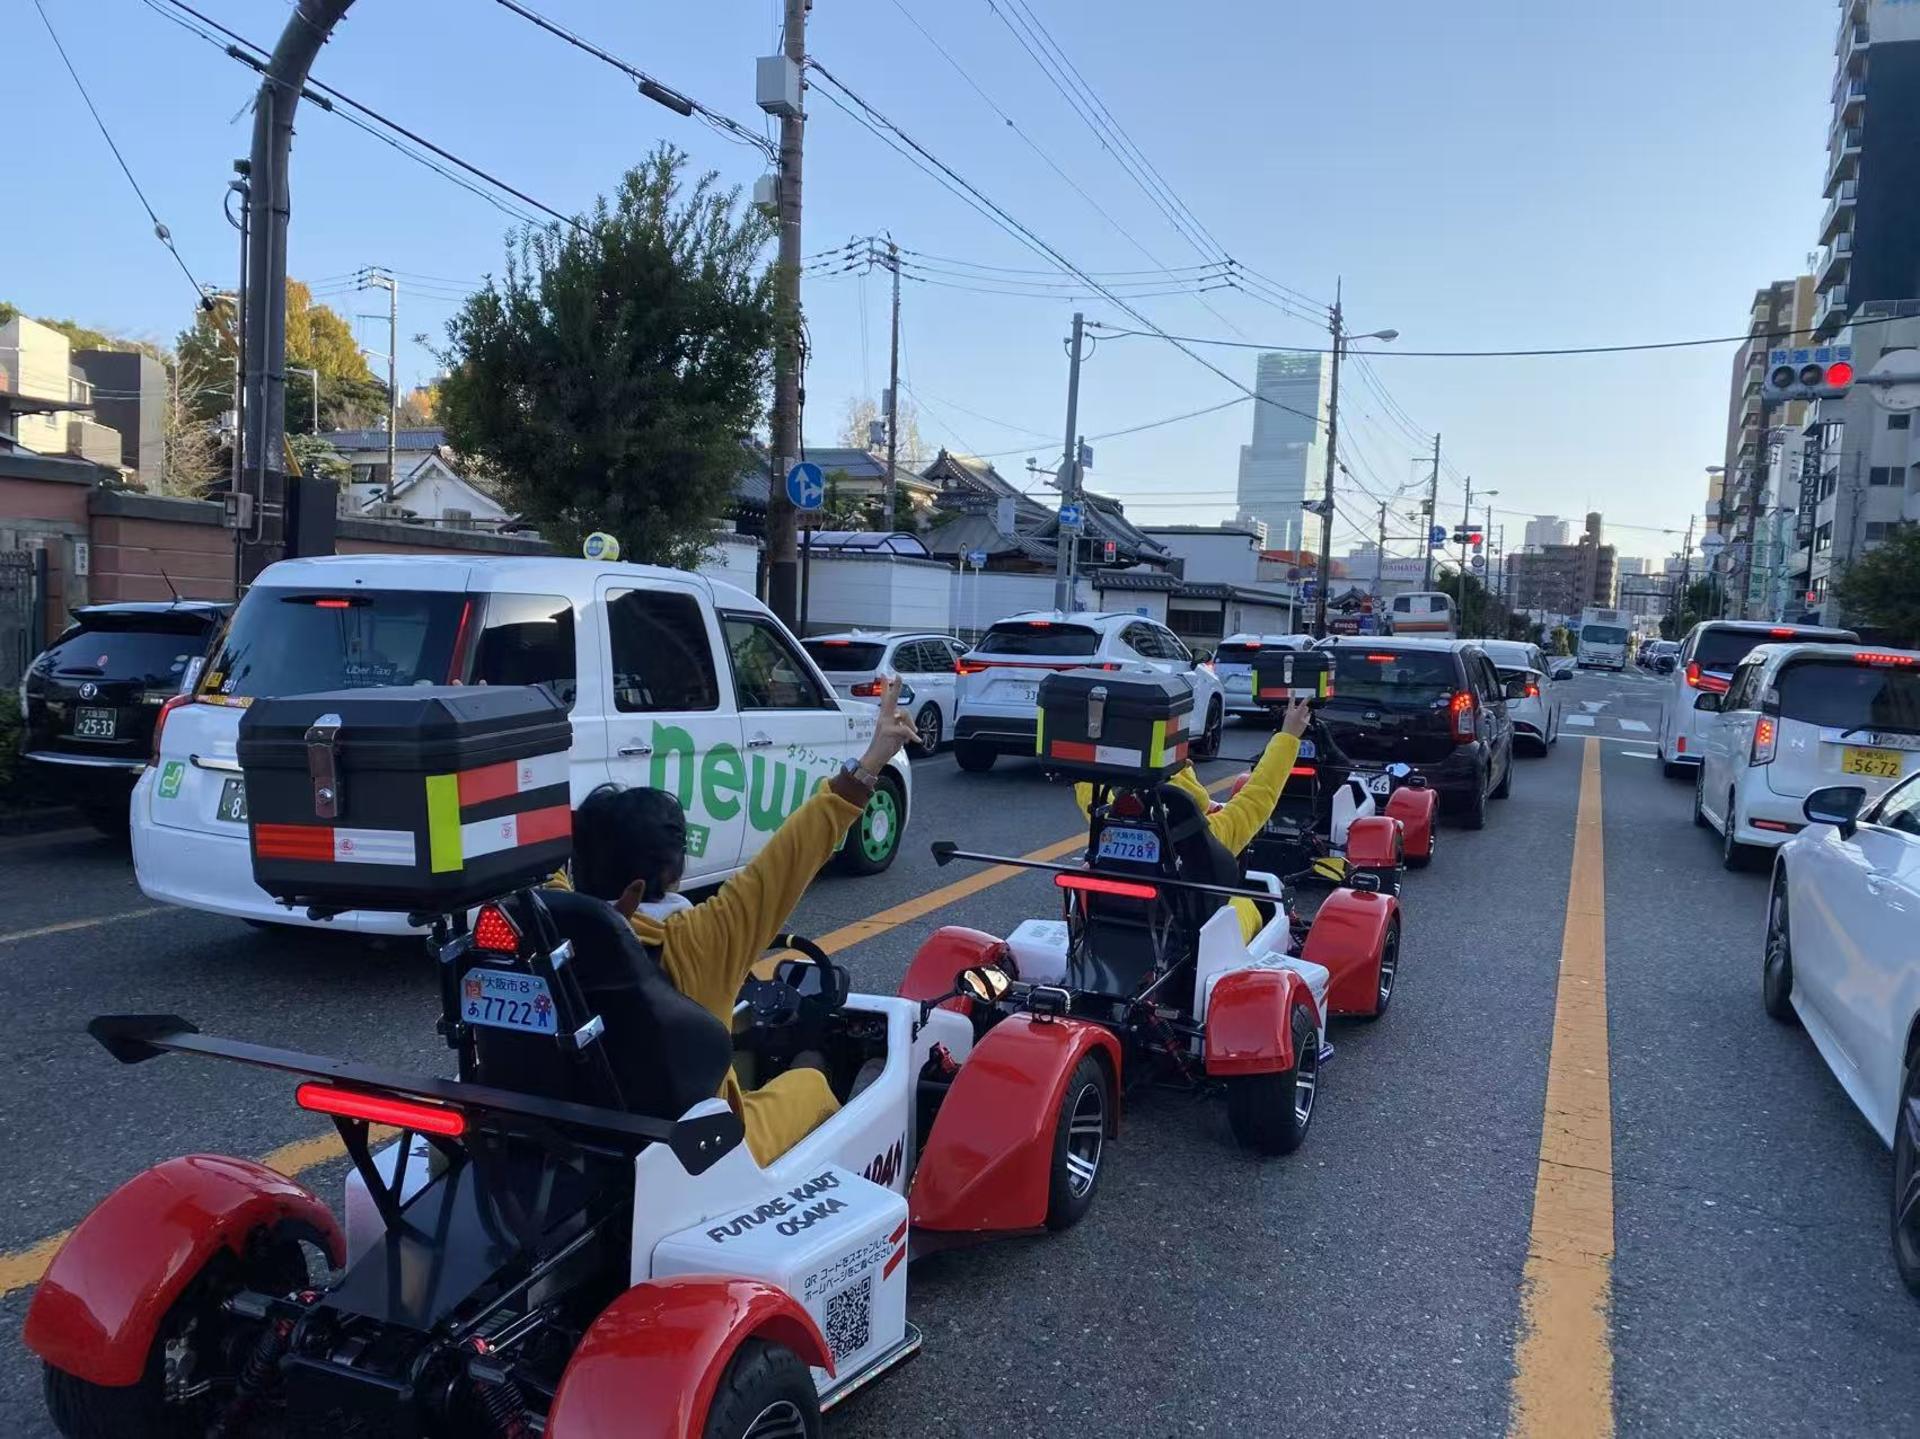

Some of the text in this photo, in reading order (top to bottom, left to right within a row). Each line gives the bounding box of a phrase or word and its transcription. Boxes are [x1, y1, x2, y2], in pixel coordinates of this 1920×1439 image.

[83, 718, 114, 735] 25-33
[1854, 759, 1898, 776] 56-72
[1112, 842, 1145, 858] 7728
[481, 996, 532, 1026] 7722
[857, 1131, 905, 1188] PAN
[706, 1171, 840, 1243] FUTURE KART
[776, 1198, 849, 1236] OSAKA
[804, 1273, 818, 1289] QR
